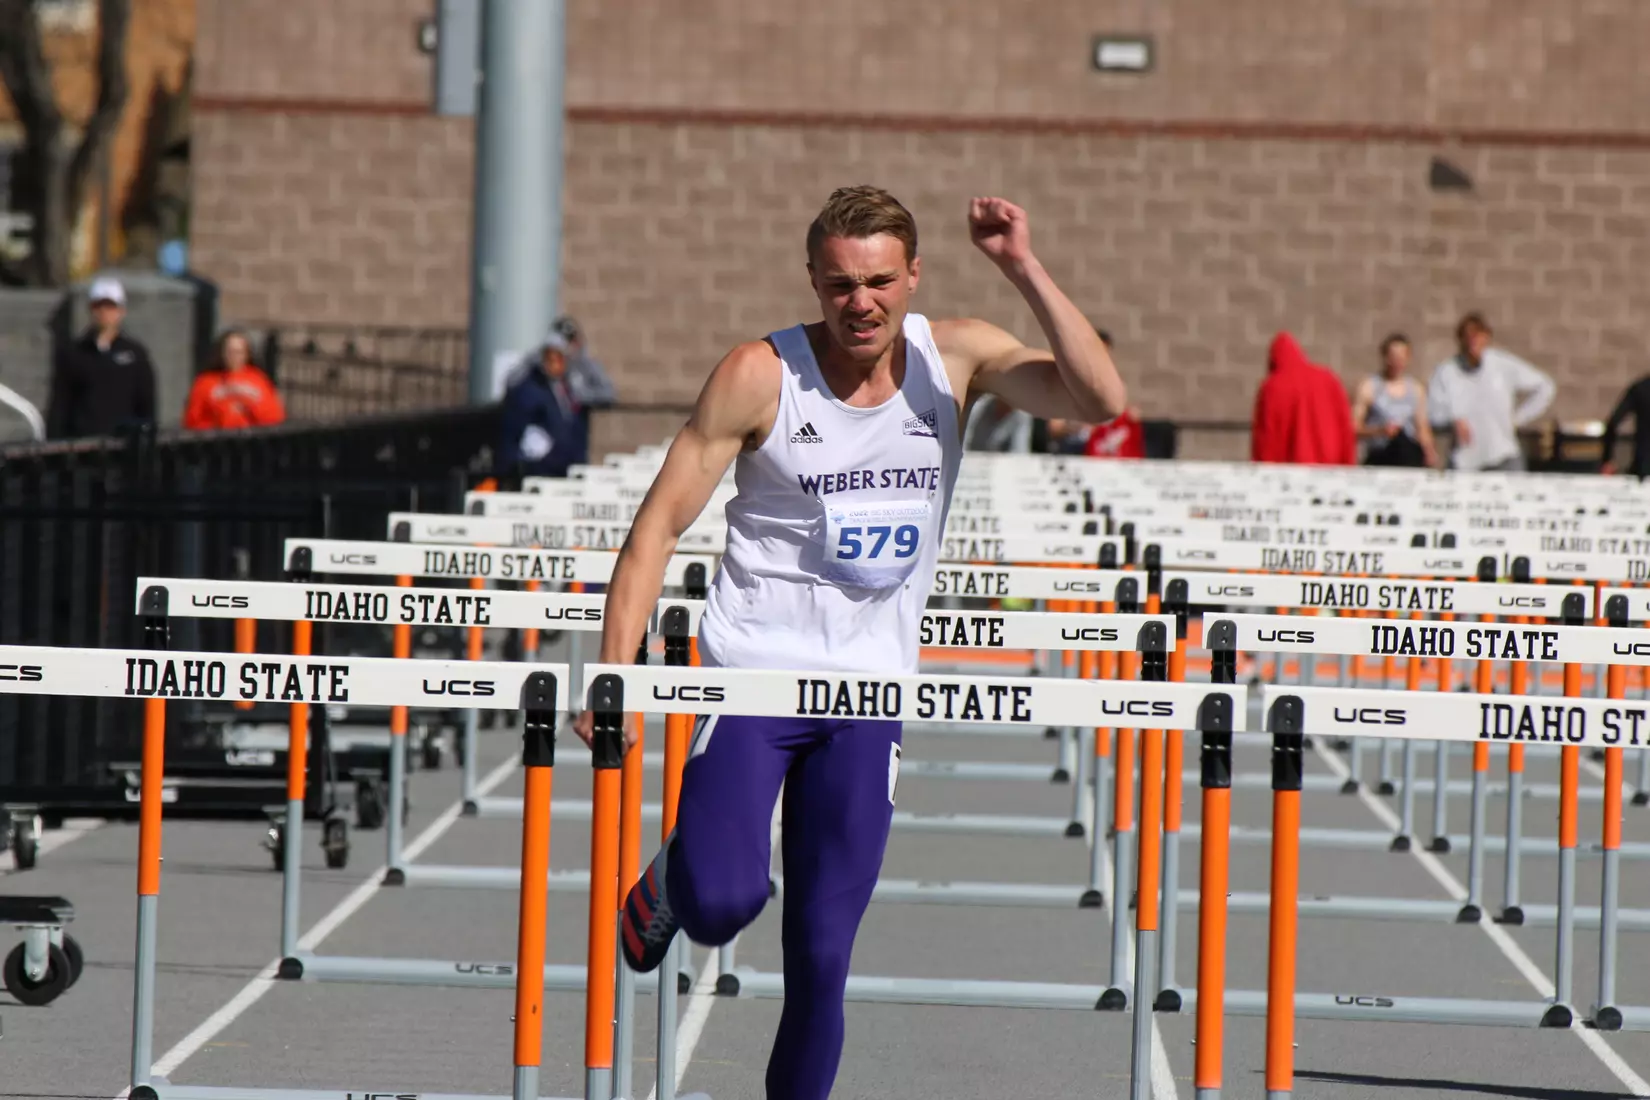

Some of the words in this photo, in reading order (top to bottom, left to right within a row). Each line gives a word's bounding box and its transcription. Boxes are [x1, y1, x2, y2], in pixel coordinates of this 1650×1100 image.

[791, 435, 823, 444] adidas
[798, 470, 875, 497] WEBER
[879, 467, 940, 490] STATE
[836, 525, 920, 559] 579
[944, 539, 1004, 561] STATE
[331, 555, 376, 565] UCS
[424, 551, 491, 576] IDAHO
[502, 554, 575, 579] STATE
[1261, 548, 1316, 571] IDAHO
[1323, 553, 1384, 573] STATE
[936, 571, 1009, 595] STATE
[1054, 582, 1100, 592] UCS
[1208, 586, 1254, 596] UCS
[1301, 583, 1368, 607] IDAHO
[1379, 586, 1453, 610] STATE
[1499, 597, 1546, 607] UCS
[192, 595, 248, 608] UCS
[305, 591, 388, 621] IDAHO
[400, 594, 490, 625] STATE
[546, 608, 601, 620] UCS
[919, 616, 1004, 646] STATE
[1062, 629, 1118, 641] UCS
[1258, 630, 1314, 643] UCS
[1371, 626, 1454, 656] IDAHO
[1467, 629, 1558, 660] STATE
[1613, 643, 1650, 656] UC
[0, 665, 42, 681] CS
[125, 658, 225, 697] IDAHO
[240, 662, 349, 702] STATE
[423, 680, 495, 696] UCS
[654, 686, 724, 701] UCS
[797, 679, 901, 717] IDAHO
[917, 683, 1031, 721] STATE
[1102, 700, 1173, 716] UCS
[1335, 708, 1406, 724] UCS
[1480, 703, 1585, 742] IDAHO
[455, 963, 513, 975] UCS
[1335, 996, 1393, 1007] UCS
